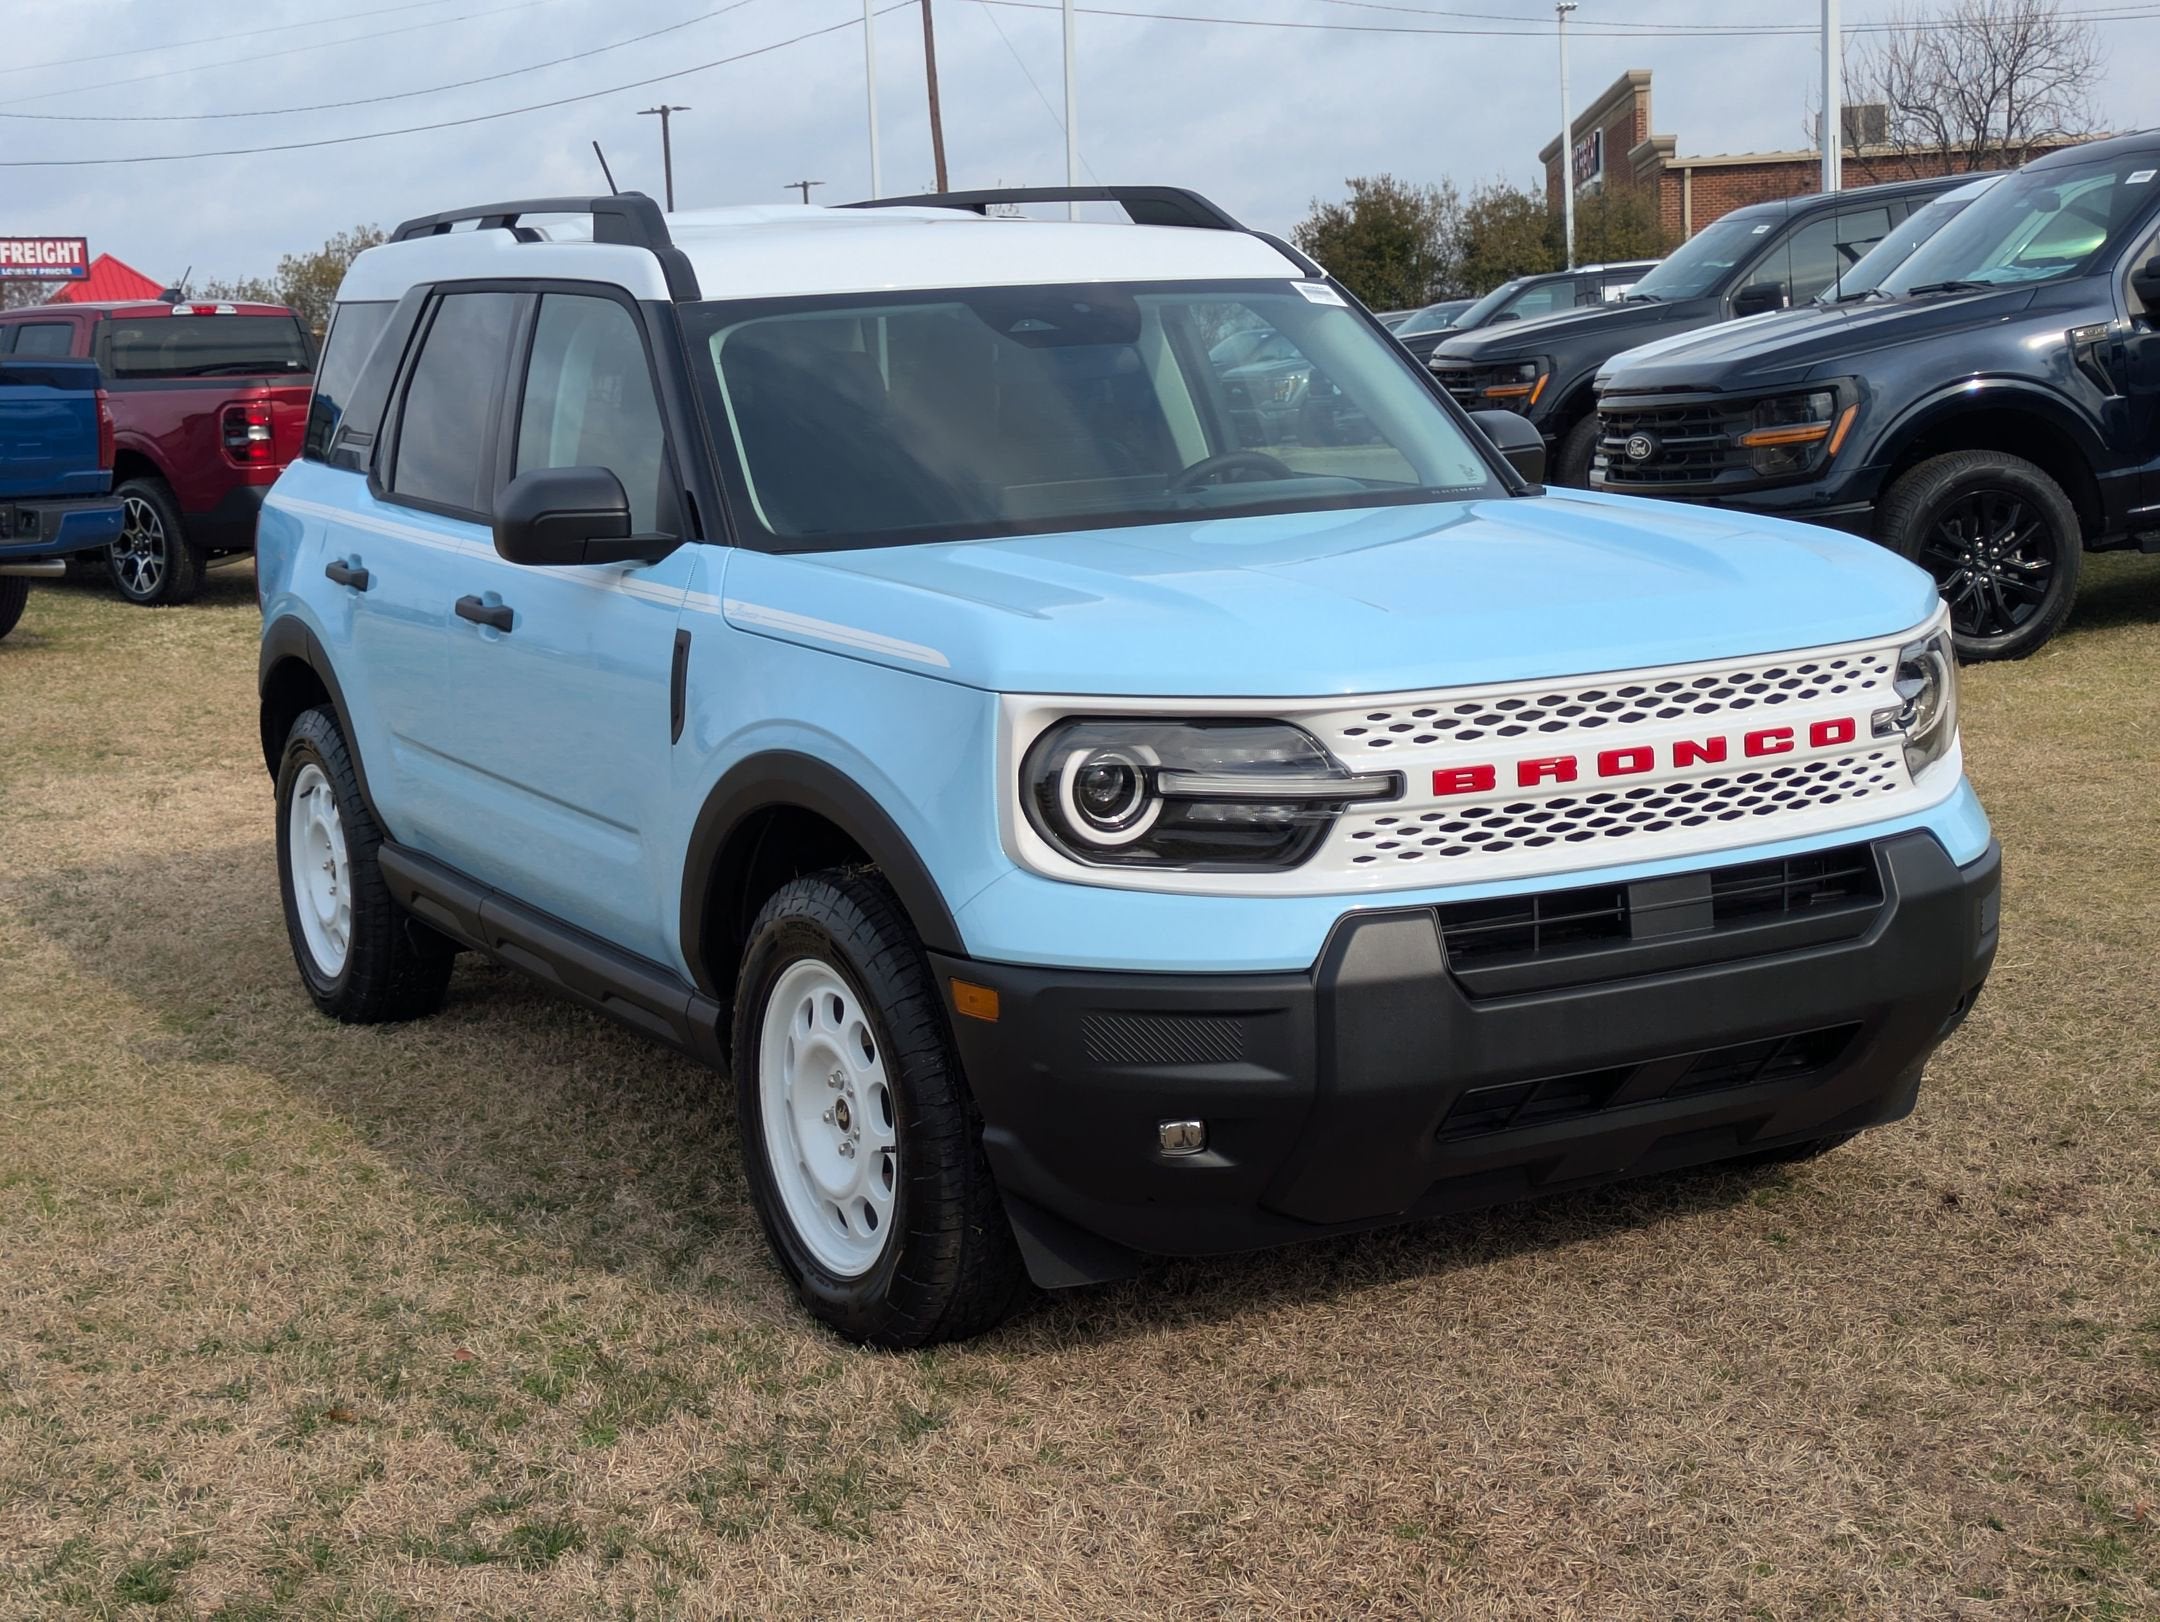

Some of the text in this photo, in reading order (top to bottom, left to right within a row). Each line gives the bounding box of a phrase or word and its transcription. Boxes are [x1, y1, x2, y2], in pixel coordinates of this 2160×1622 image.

[0, 241, 82, 264] FREIGHT
[1629, 439, 1648, 456] Ford
[1432, 716, 1857, 797] BRONCO
